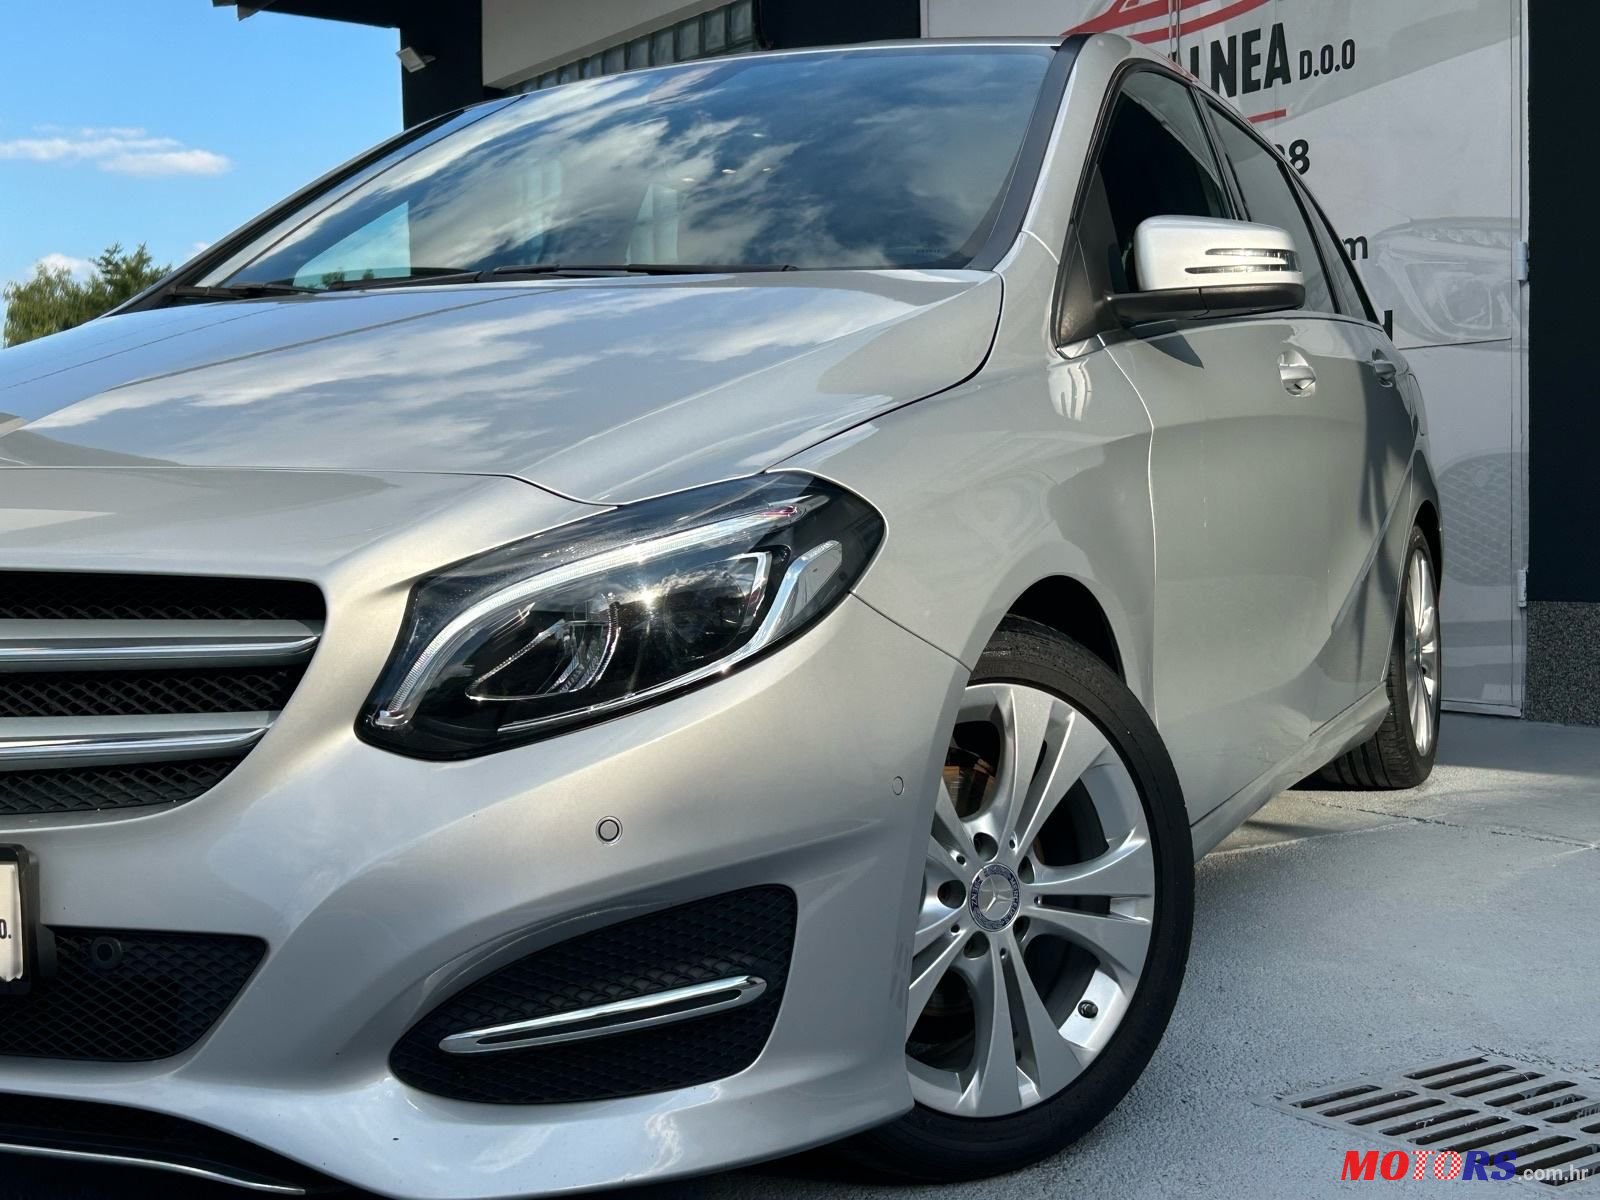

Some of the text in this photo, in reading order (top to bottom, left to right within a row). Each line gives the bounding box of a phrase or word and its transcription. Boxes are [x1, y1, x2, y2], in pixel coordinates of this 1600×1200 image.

[1168, 22, 1356, 98] NEA D.O.O
[1275, 139, 1310, 175] 8
